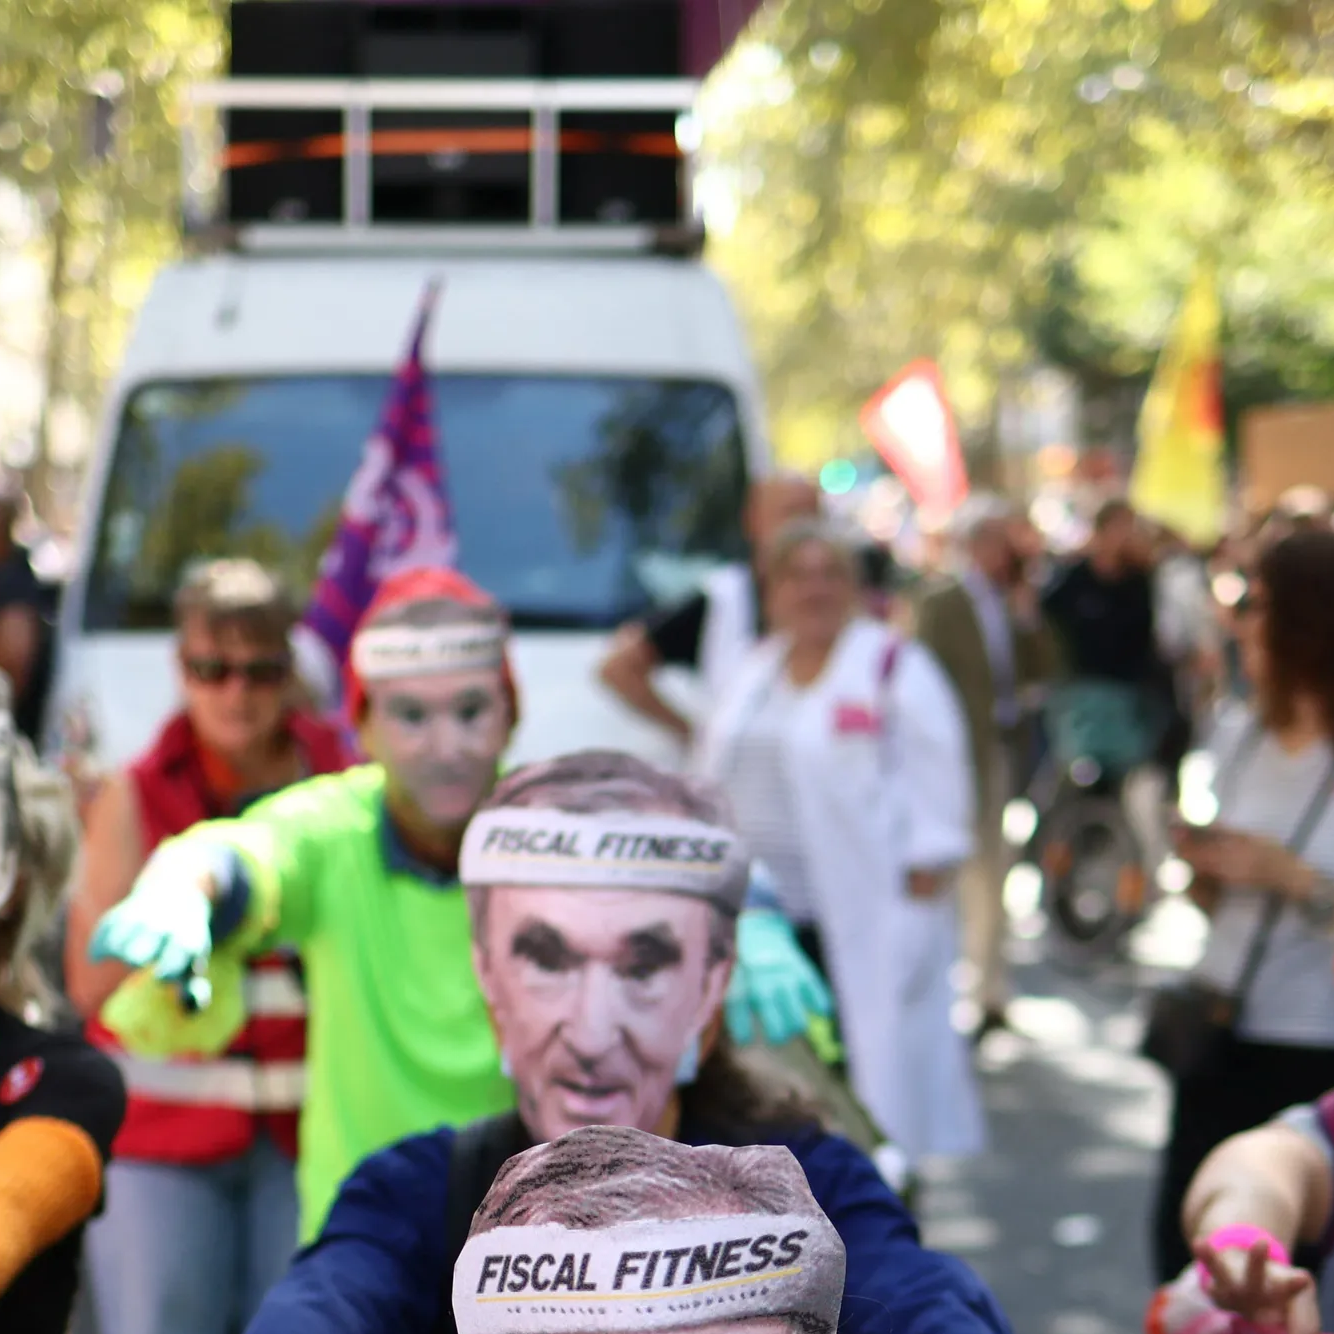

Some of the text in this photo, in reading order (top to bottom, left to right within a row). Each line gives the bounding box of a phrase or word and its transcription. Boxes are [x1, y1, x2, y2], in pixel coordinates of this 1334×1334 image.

[481, 826, 732, 864] FISCAL FITNESS
[475, 1229, 809, 1294] FISCAL FITNESS
